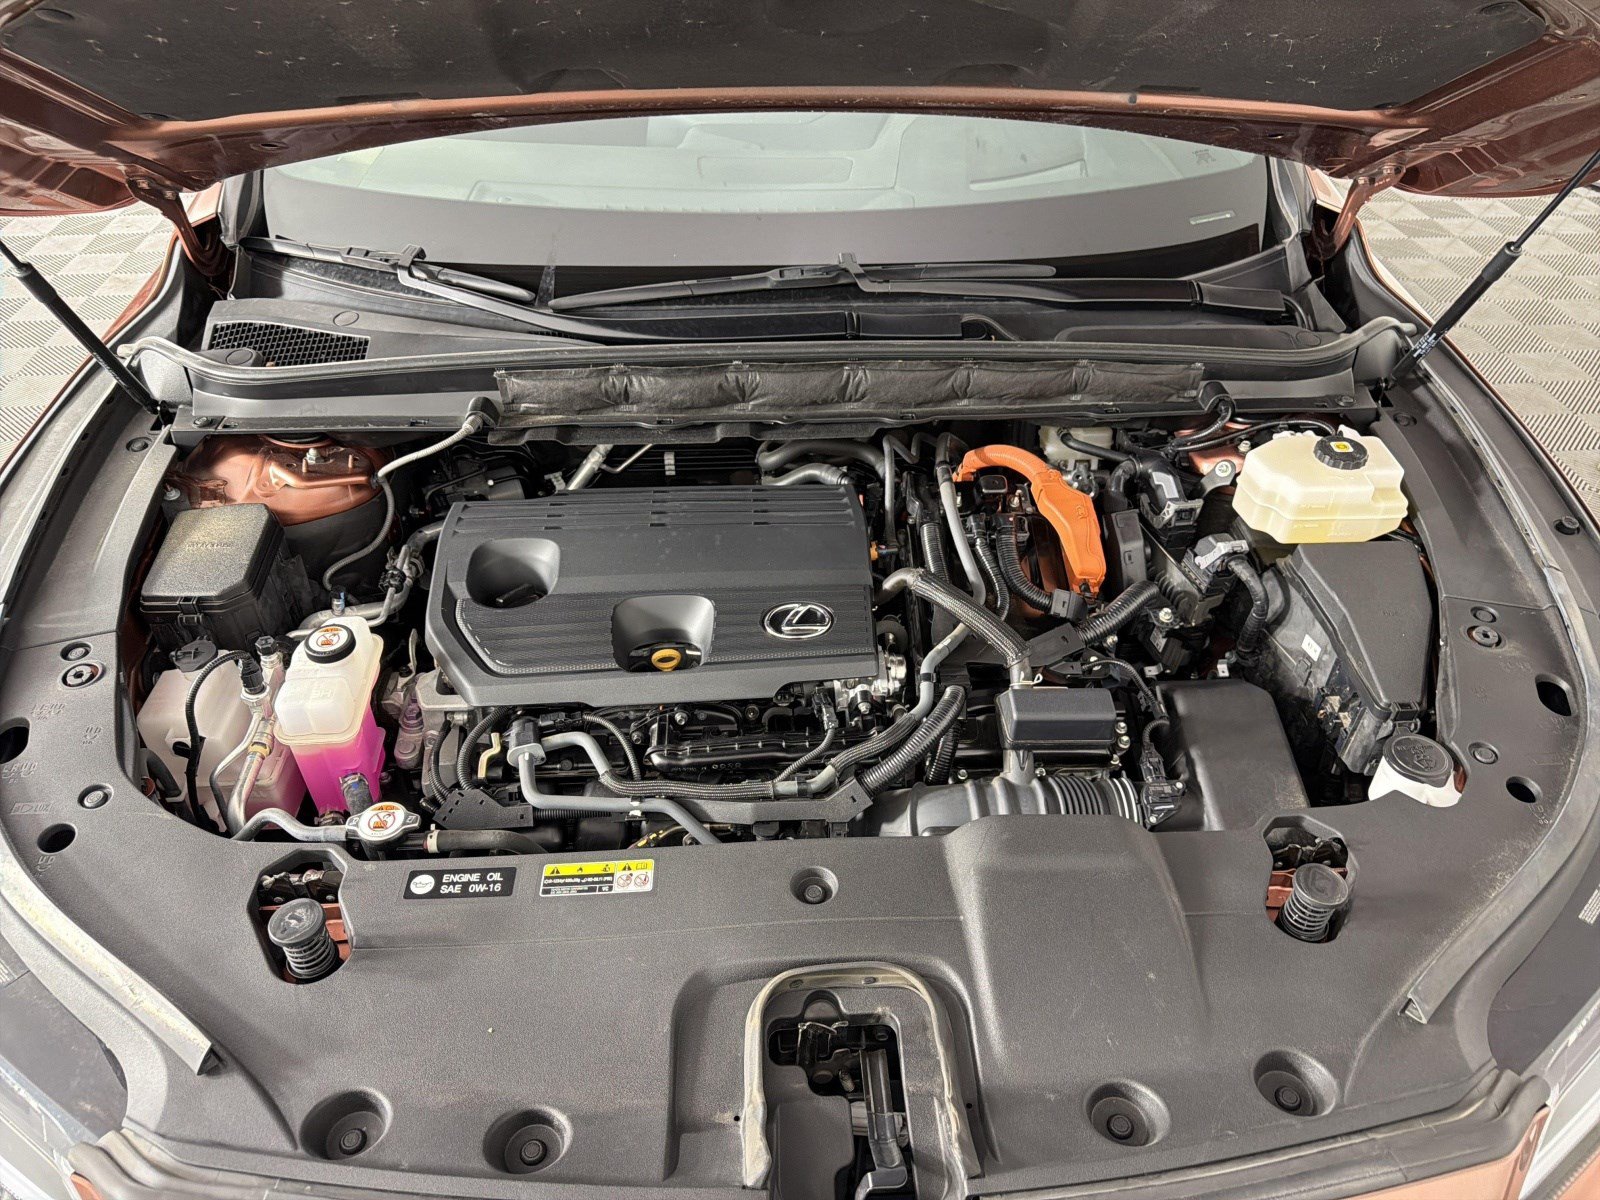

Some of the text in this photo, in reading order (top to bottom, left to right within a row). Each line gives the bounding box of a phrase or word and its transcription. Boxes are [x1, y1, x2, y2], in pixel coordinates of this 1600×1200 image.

[442, 872, 504, 883] ENGINE OIL
[440, 883, 502, 894] SAE 0W-16
